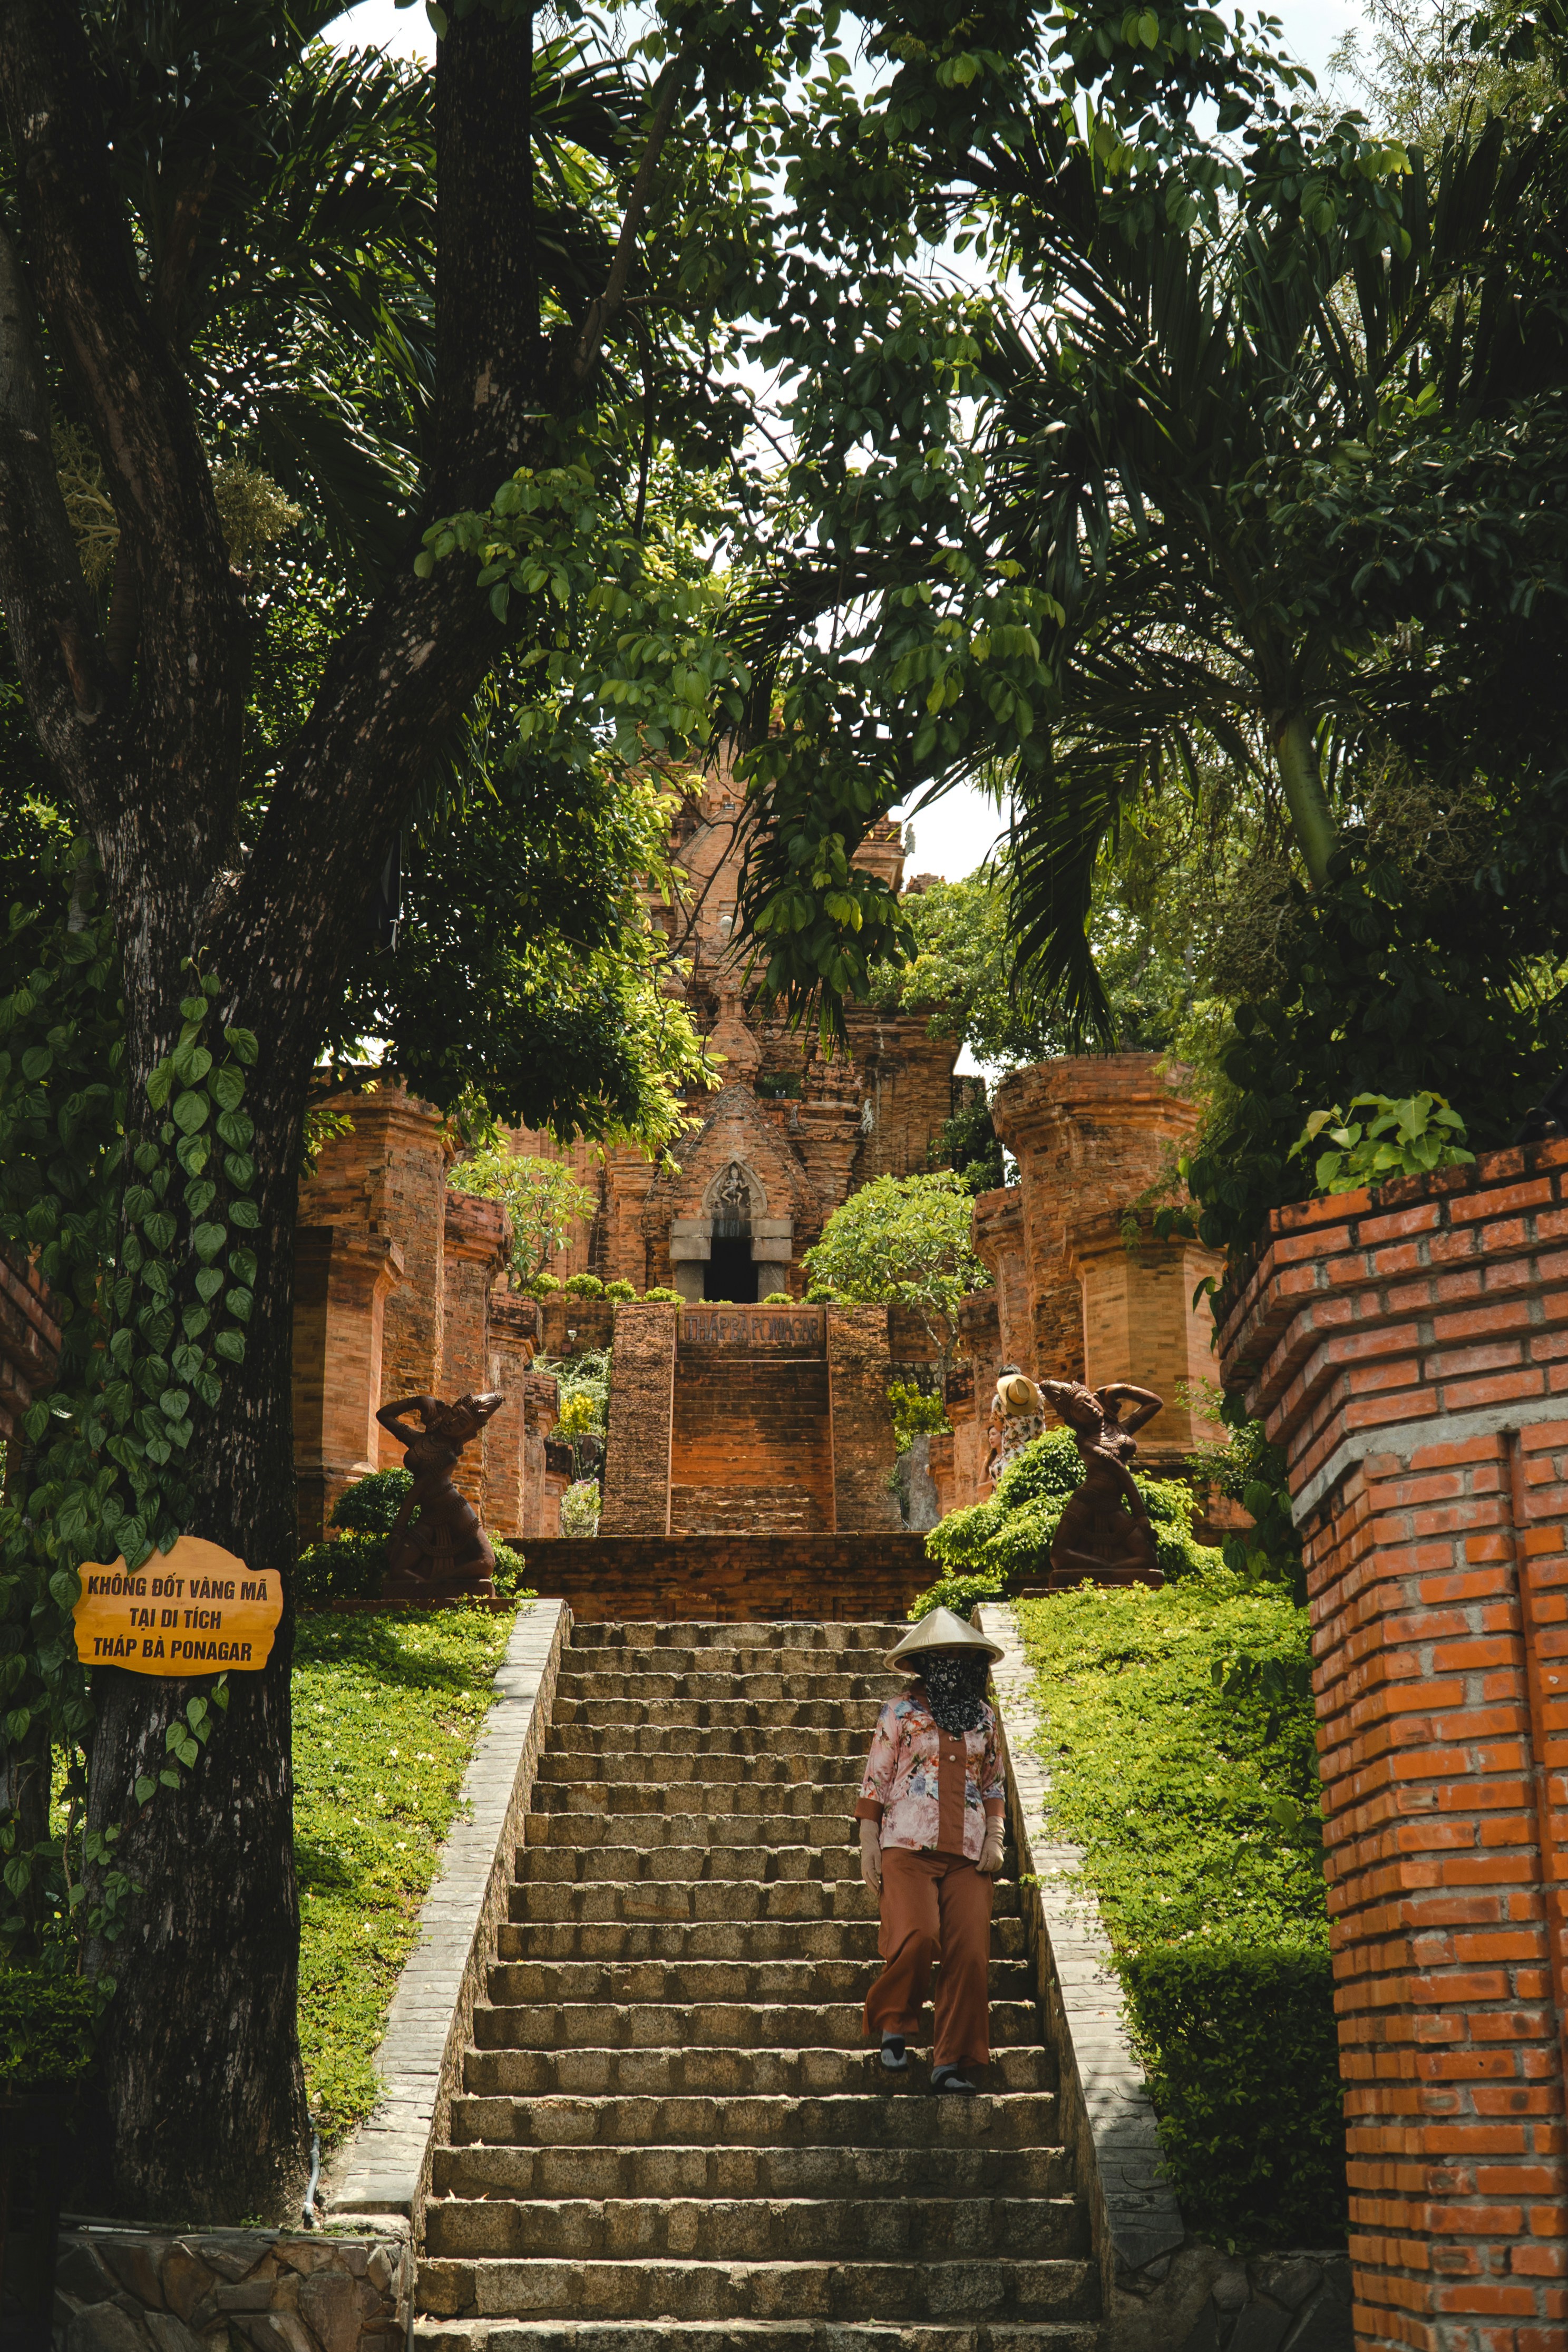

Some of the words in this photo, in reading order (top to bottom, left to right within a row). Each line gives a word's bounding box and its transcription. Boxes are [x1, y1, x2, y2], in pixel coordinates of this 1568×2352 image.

[685, 1311, 729, 1340] THÁP
[731, 1311, 750, 1340] BÀ
[751, 1317, 819, 1340] PONAGAR
[87, 1573, 147, 1596] KHÔNG
[151, 1573, 184, 1598] ĐỐT
[190, 1576, 235, 1599] VÀNG
[240, 1579, 268, 1601] MÃ
[130, 1608, 155, 1631] TẠI
[161, 1609, 178, 1628] DI
[184, 1607, 222, 1629] TÍCH
[93, 1635, 137, 1657] THÁP
[142, 1636, 164, 1658] BÀ
[171, 1640, 252, 1661] PONAGAR
